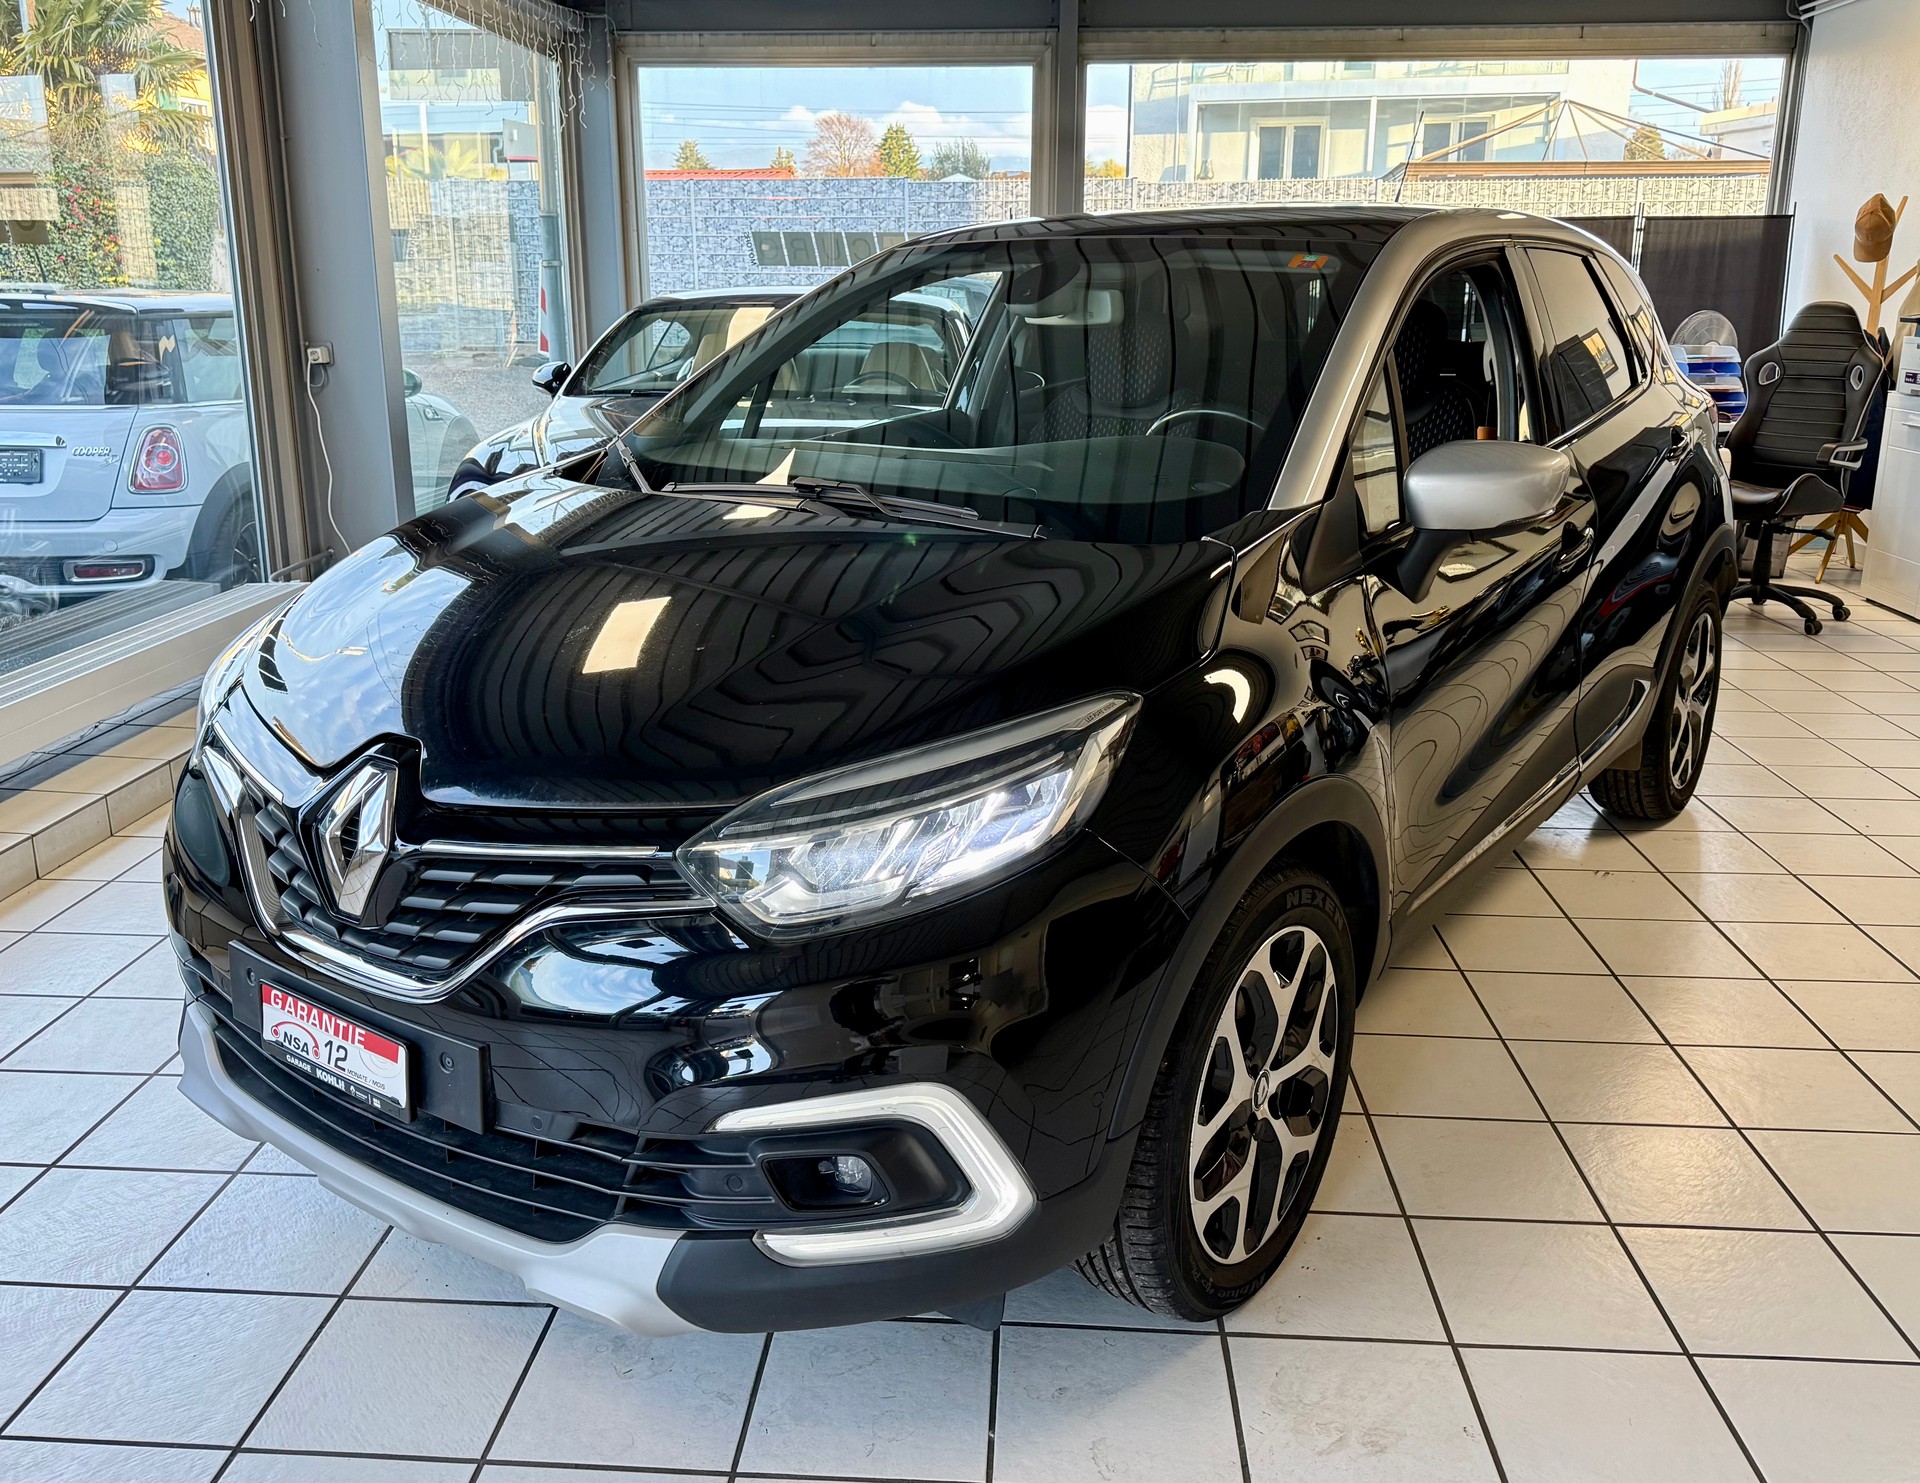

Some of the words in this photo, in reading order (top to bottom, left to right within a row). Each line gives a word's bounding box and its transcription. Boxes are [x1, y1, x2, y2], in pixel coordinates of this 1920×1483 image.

[71, 446, 111, 457] COOPER
[1286, 888, 1344, 931] NEXEN
[270, 989, 366, 1048] GARANTIE
[283, 1031, 310, 1056] NSA
[286, 1054, 312, 1073] GARAGE
[323, 1040, 348, 1073] 12
[347, 1068, 368, 1083] MONATE
[372, 1080, 386, 1091] MOIS
